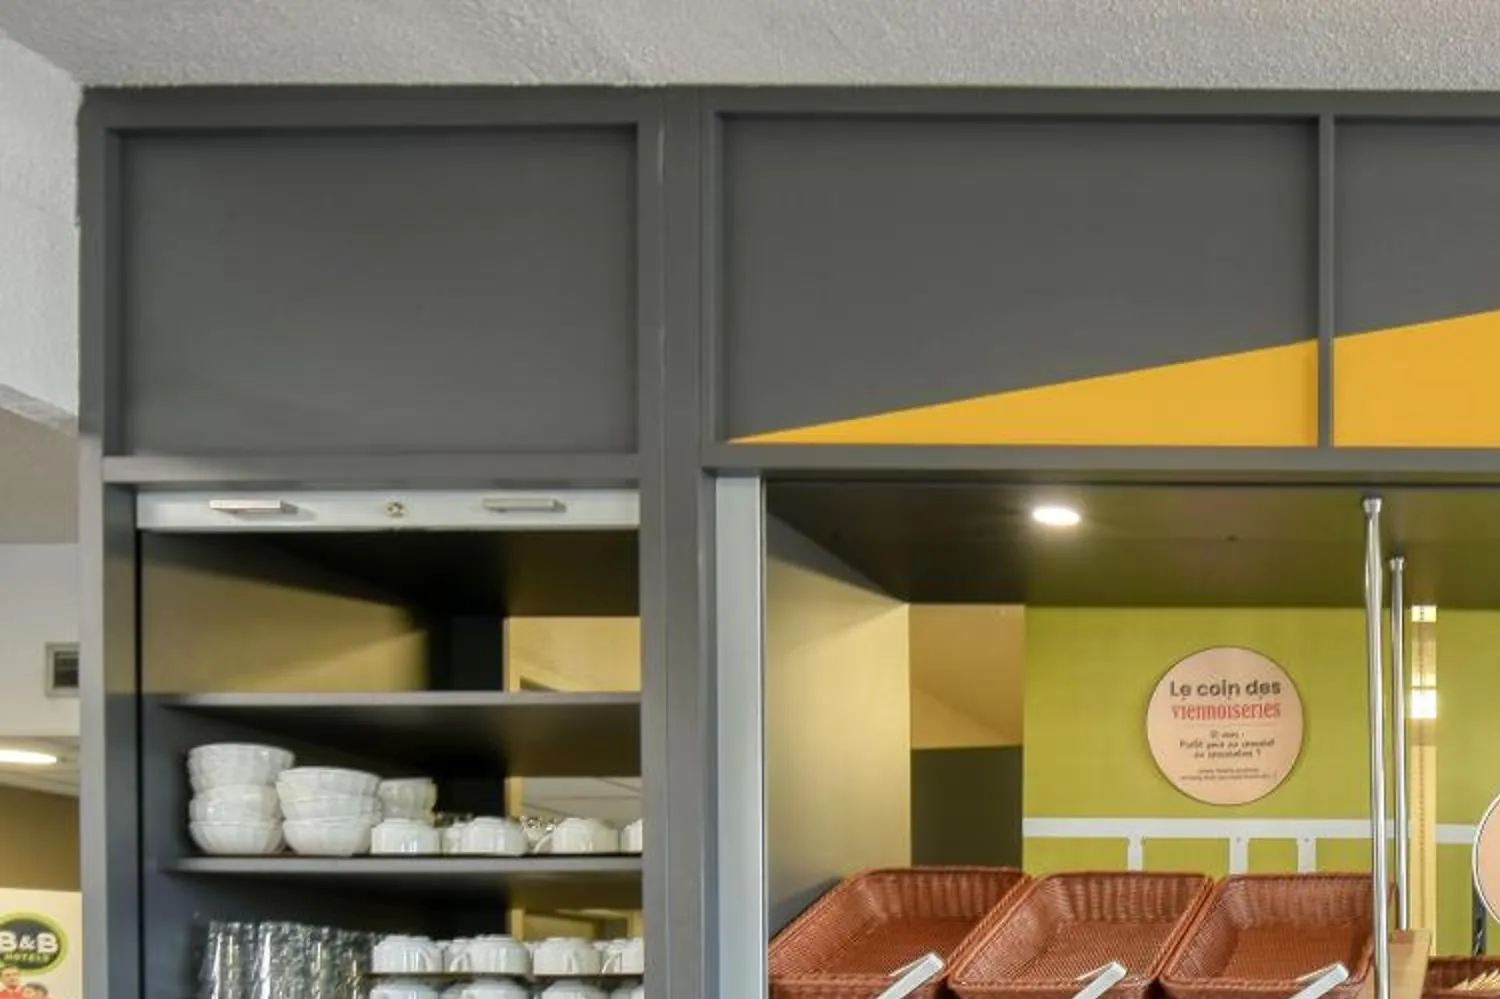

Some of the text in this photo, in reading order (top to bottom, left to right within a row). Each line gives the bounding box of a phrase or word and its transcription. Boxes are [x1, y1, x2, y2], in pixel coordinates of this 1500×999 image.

[1169, 679, 1281, 697] Le coin des
[1171, 702, 1282, 720] viennoiseries
[0, 930, 58, 953] B&B
